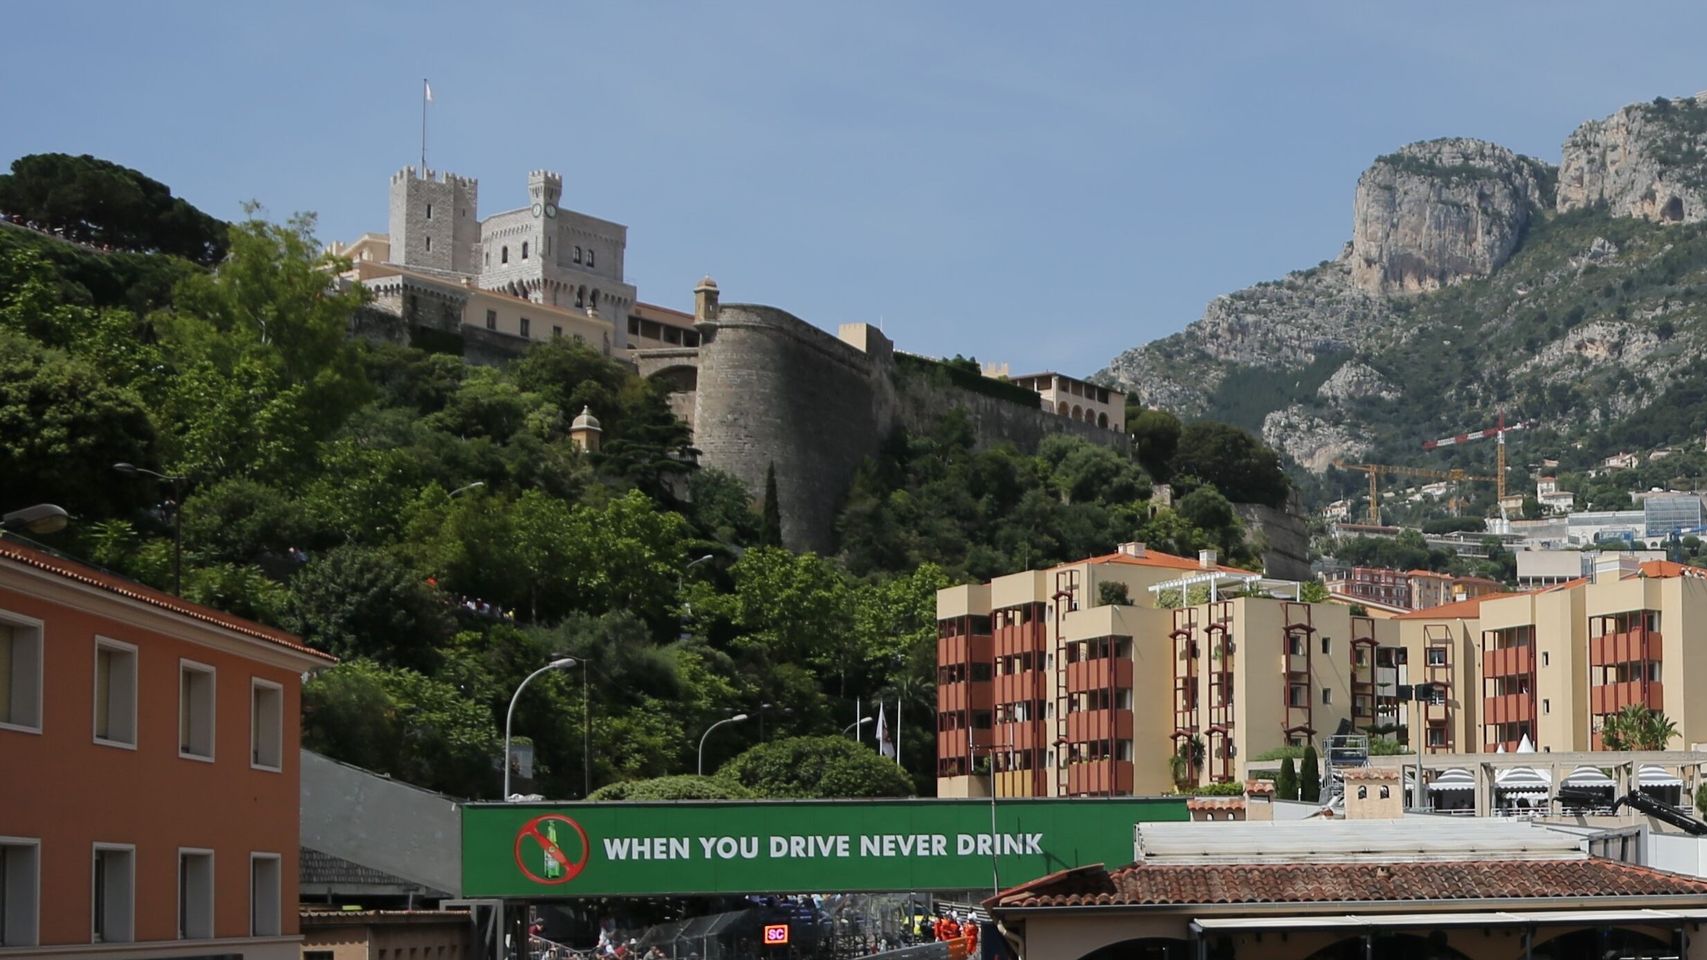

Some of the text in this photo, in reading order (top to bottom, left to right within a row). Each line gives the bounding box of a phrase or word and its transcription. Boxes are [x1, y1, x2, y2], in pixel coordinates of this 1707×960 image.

[603, 833, 1044, 860] WHEN YOU DRIVE NEVER DRINK
[768, 928, 784, 940] SC
